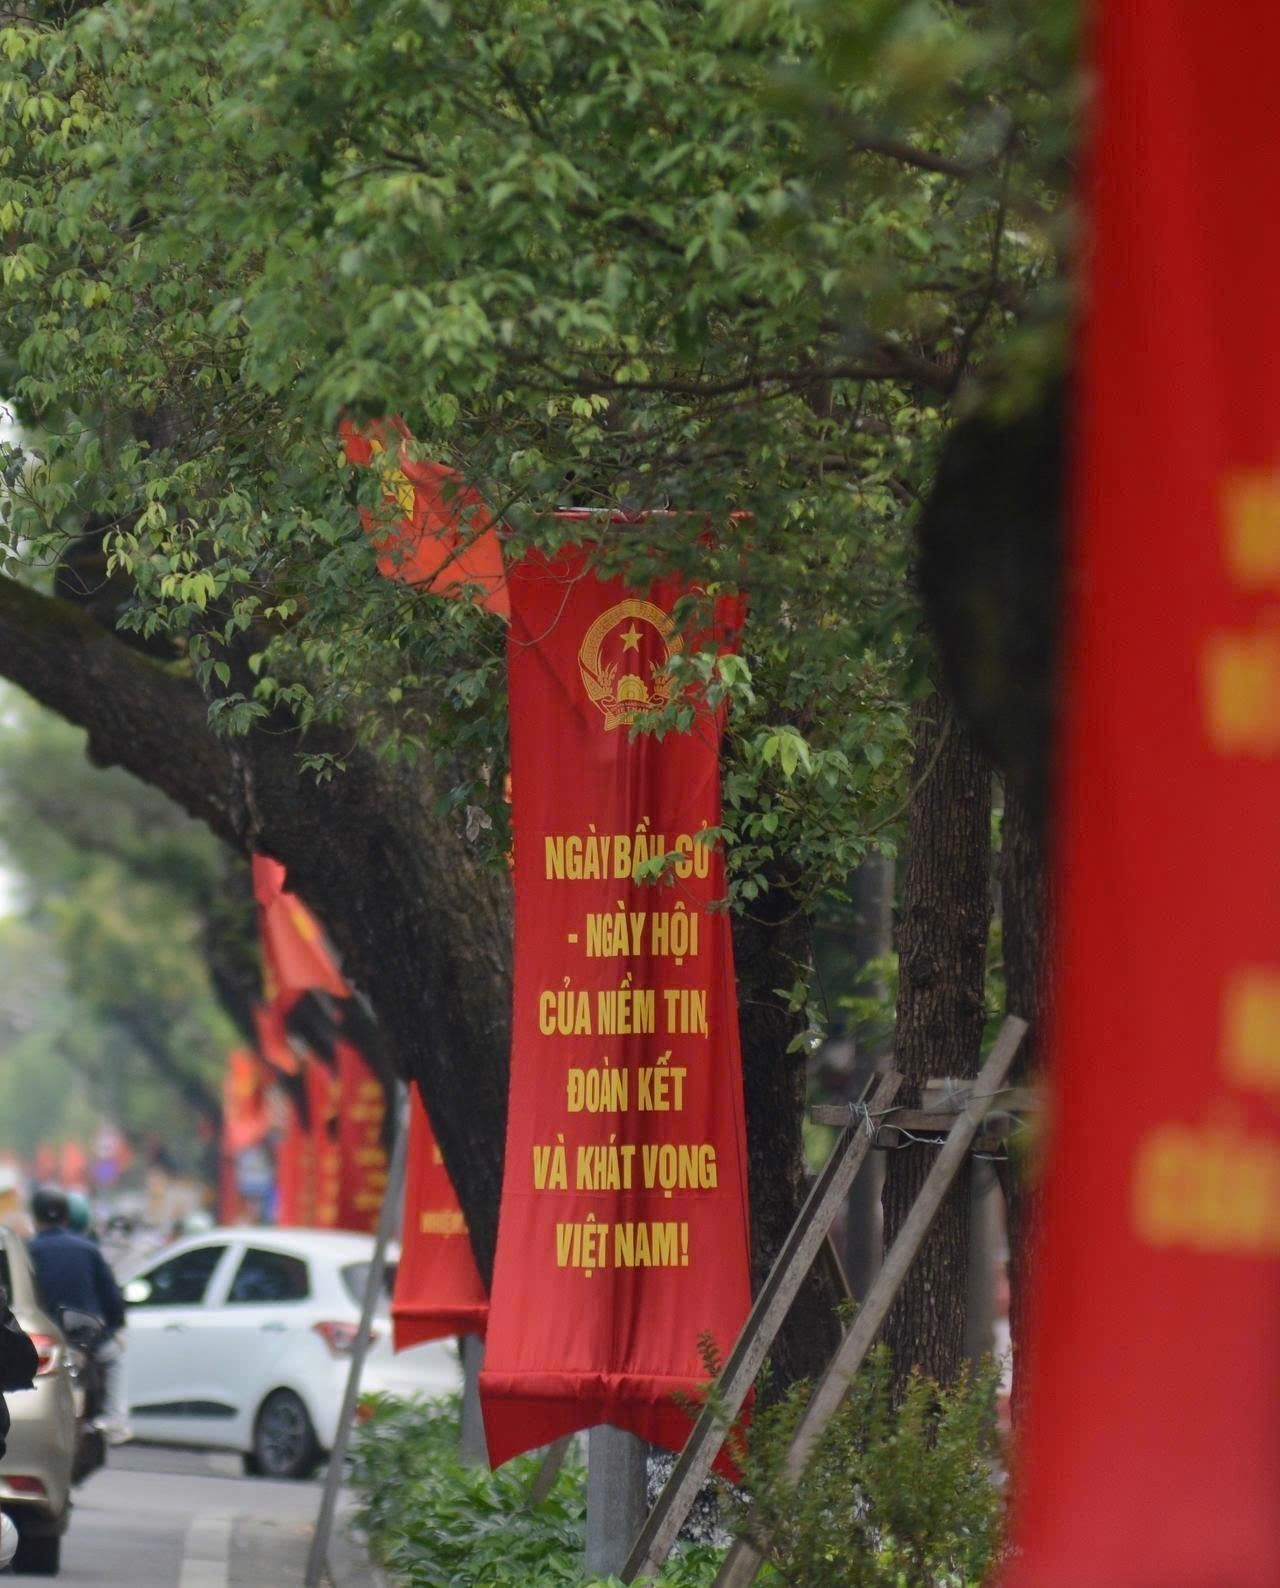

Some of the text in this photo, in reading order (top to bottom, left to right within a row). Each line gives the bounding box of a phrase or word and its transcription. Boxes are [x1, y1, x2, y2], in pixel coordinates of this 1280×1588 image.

[545, 823, 611, 880] NGÀY
[586, 901, 647, 958] NGÀY
[652, 901, 698, 966] HỘI
[539, 972, 708, 1040] CỦA NIỀM TIN,
[567, 1050, 687, 1113] ĐOÀN KẾT
[533, 1134, 718, 1198] VÀ KHÁT VỌNG
[556, 1213, 690, 1278] VIỆT NAM!
